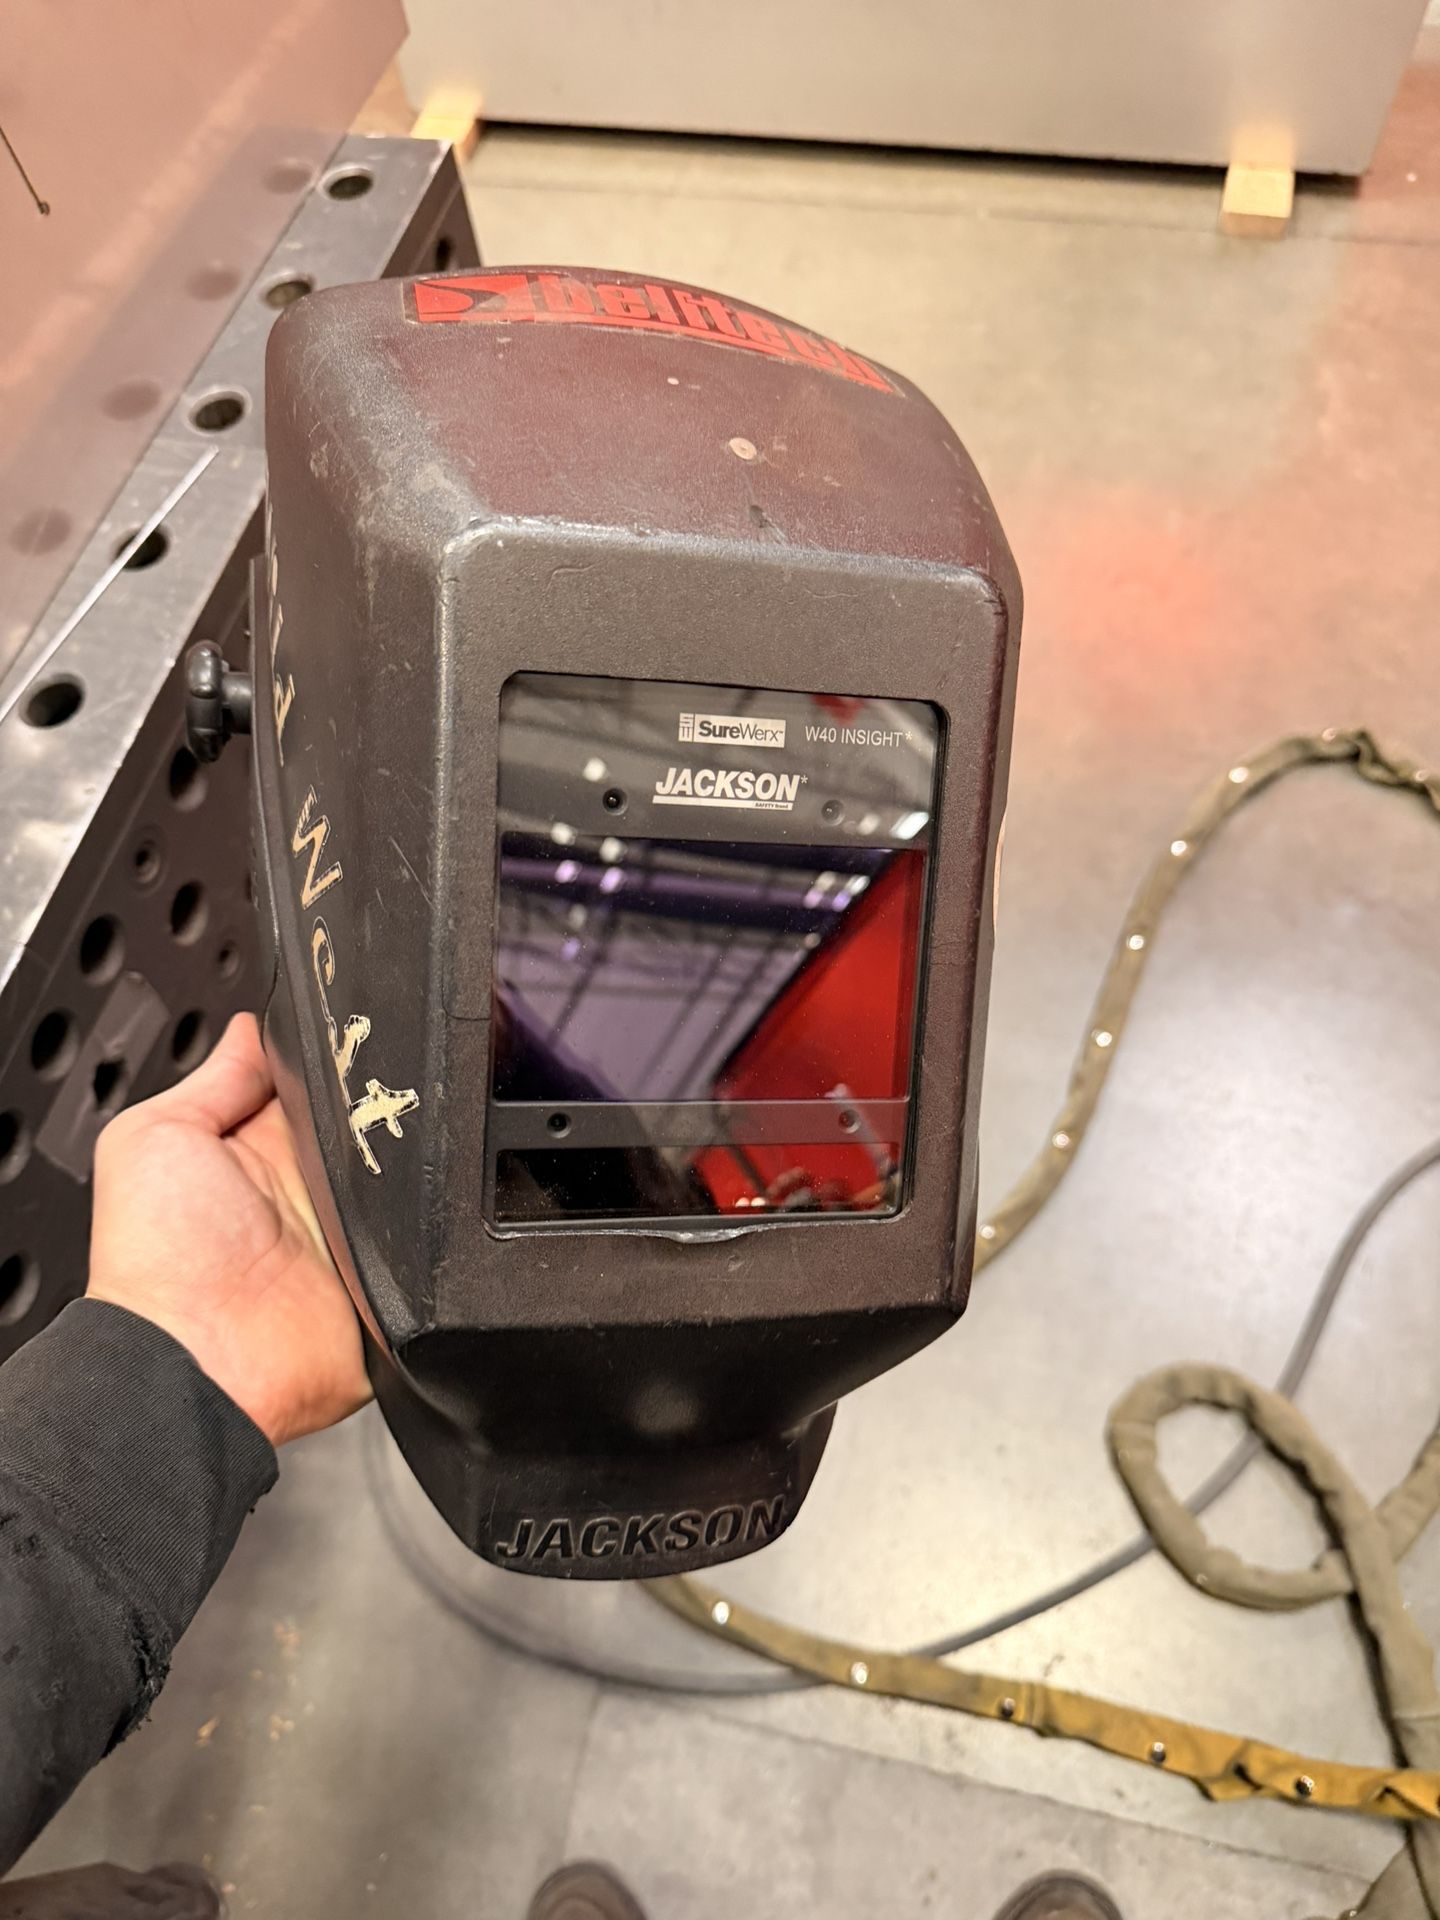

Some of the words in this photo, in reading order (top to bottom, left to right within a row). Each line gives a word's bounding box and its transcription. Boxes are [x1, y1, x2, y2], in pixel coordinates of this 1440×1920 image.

[804, 725, 837, 744] W40
[292, 784, 421, 1175] West
[495, 1495, 786, 1559] JACKSON
